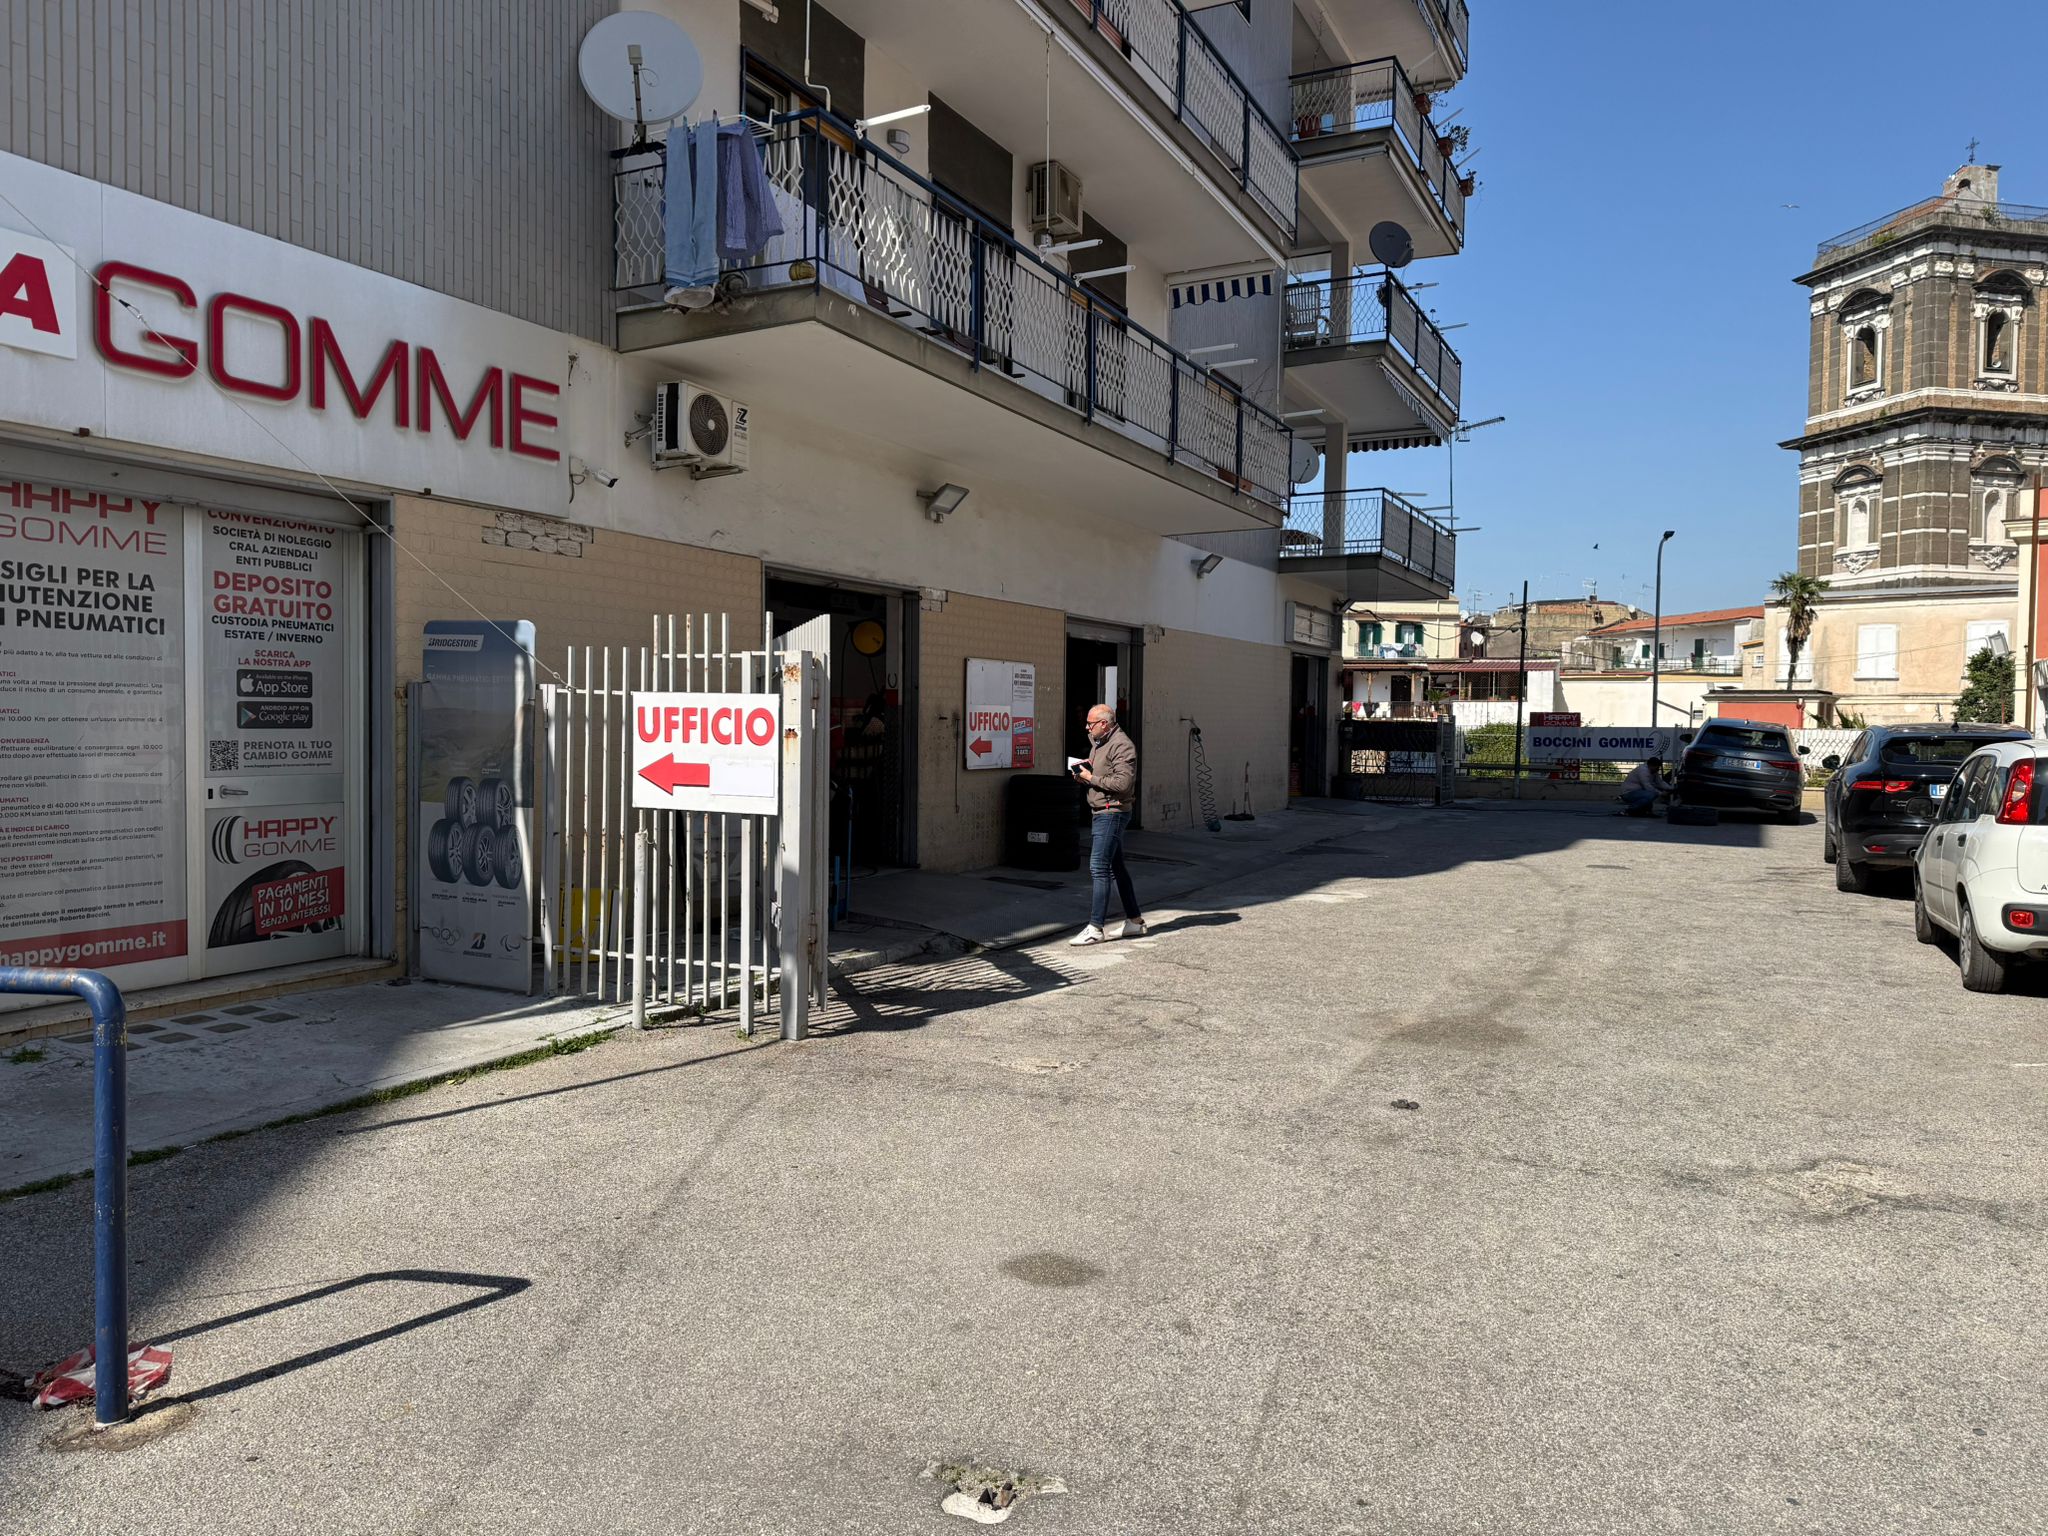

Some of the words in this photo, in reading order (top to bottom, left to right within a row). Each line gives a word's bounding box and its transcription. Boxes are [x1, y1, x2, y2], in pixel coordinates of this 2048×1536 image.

[94, 260, 560, 462] GOMME
[213, 525, 260, 540] SOCIETÀ
[264, 532, 275, 541] DI
[278, 534, 331, 549] NOLEGGIO
[229, 542, 259, 553] CRAL
[262, 545, 317, 560] AZIENDALI
[236, 556, 260, 567] ENTI
[264, 559, 312, 572] PUBBLICI
[1, 560, 67, 584] SIGLI
[78, 568, 119, 588] PER
[128, 573, 155, 592] LA
[213, 570, 332, 599] DEPOSITO
[0, 584, 152, 613] UTENZIONE
[213, 594, 332, 621] GRATUITO
[17, 609, 165, 635] PNEUMATICI
[211, 615, 268, 628] CUSTODIA
[272, 620, 334, 631] PNEUMATICI
[225, 630, 265, 640] ESTATE
[276, 633, 323, 643] INVERNO
[253, 659, 291, 667] NOSTRA
[293, 660, 311, 668] APP
[255, 650, 295, 658] SCARICA
[256, 681, 279, 695] App
[281, 681, 308, 693] Store
[259, 711, 291, 724] Google
[292, 712, 309, 723] play
[638, 706, 775, 746] UFFICIO
[969, 712, 1010, 731] UFFICIO
[244, 741, 294, 750] PRENOTA
[298, 741, 307, 749] IL
[310, 740, 332, 749] TUO
[1533, 737, 1591, 748] BOCCINI
[1599, 737, 1654, 749] GOMME
[243, 751, 287, 760] CAMBIO
[291, 751, 333, 759] GOMME
[244, 816, 335, 839] HAPPY
[244, 838, 336, 857] GOMME
[258, 875, 327, 901] PAGAMENTI
[259, 902, 274, 918] IN
[280, 898, 293, 912] 10
[298, 889, 329, 910] MESI
[3, 912, 39, 921] riscontrate
[260, 913, 288, 928] SENZA
[291, 904, 330, 921] INTERESSI
